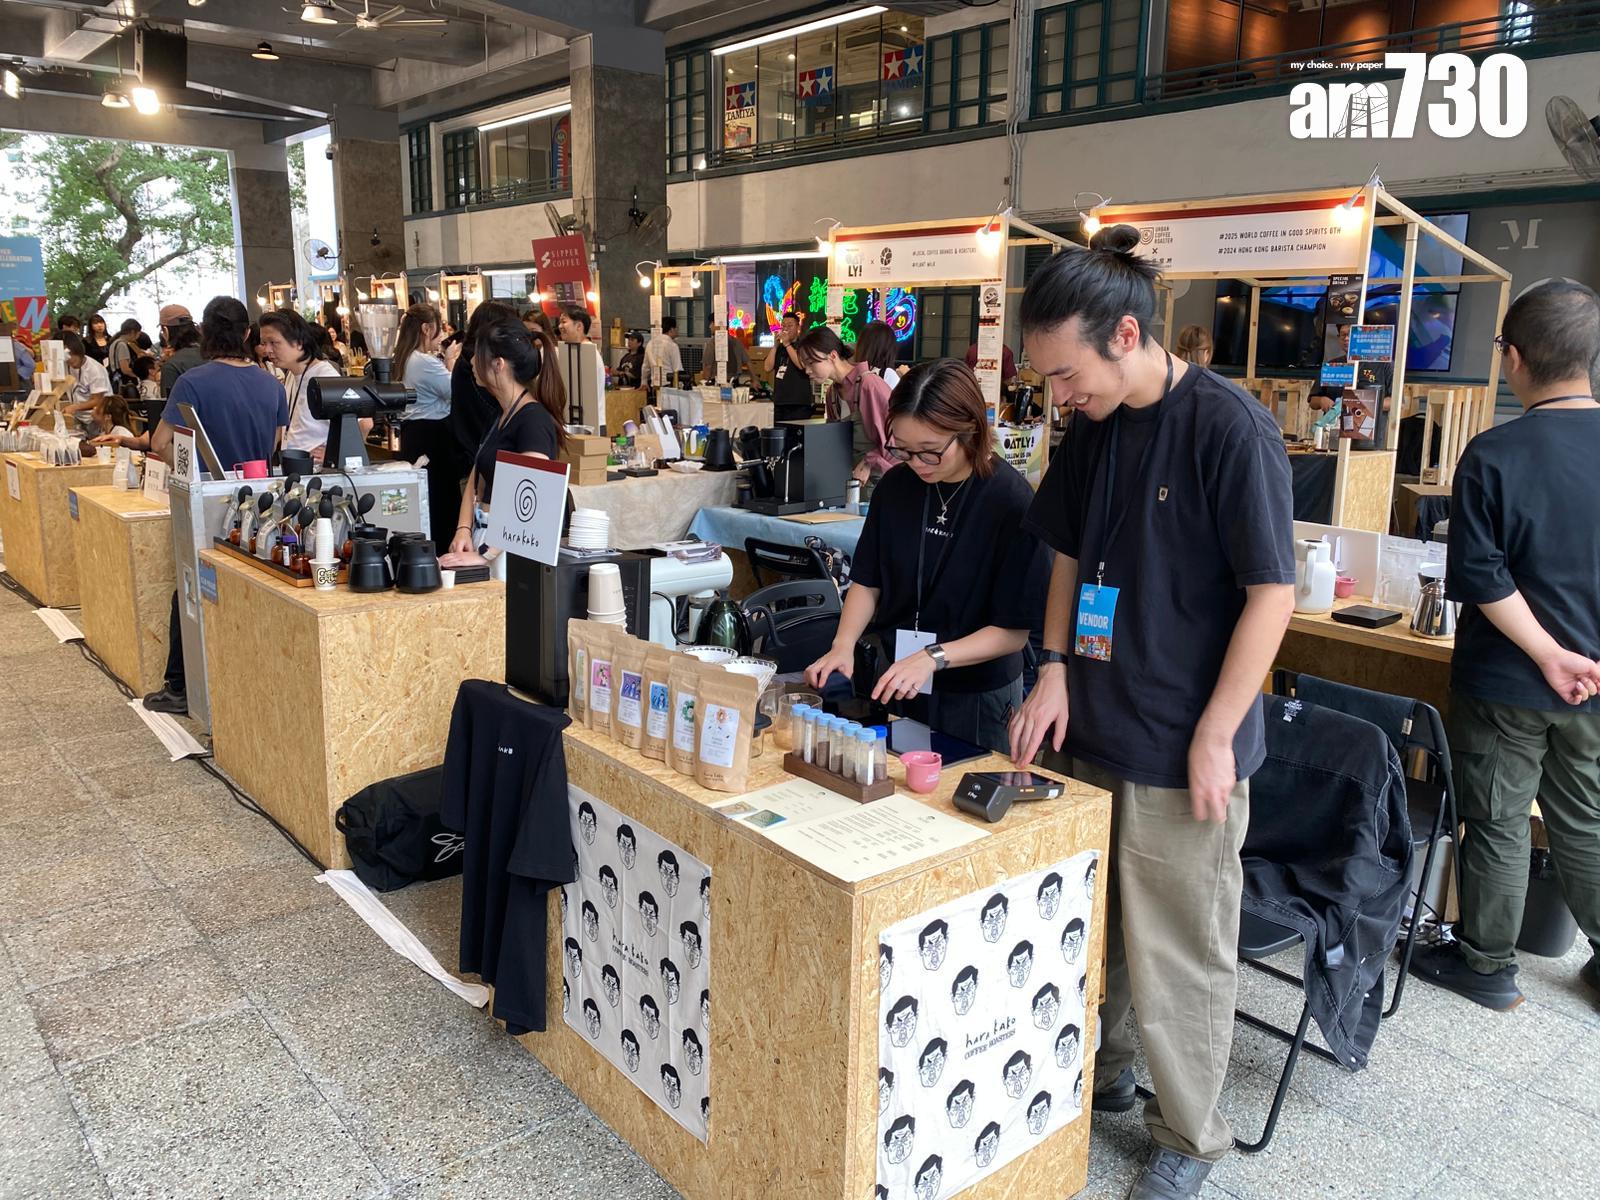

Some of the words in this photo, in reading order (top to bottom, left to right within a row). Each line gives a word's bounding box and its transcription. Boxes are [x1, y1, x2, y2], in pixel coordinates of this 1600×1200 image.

[726, 107, 756, 121] TAMIYA
[1219, 232, 1238, 240] #2025
[1239, 231, 1258, 239] WORLD
[1260, 230, 1279, 238] COFFEE
[1280, 229, 1287, 237] IN
[1288, 229, 1304, 237] GOOD
[1305, 227, 1328, 236] SPIRITS
[1497, 218, 1543, 250] M
[551, 248, 579, 258] SIPPER
[1254, 245, 1269, 253] KONG
[1270, 244, 1294, 252] BARISTA
[1296, 243, 1327, 251] CHAMPION
[552, 258, 580, 267] COFFEE
[848, 264, 863, 277] LY!
[1004, 435, 1035, 450] OATLY!
[1079, 612, 1109, 630] VENDOR
[964, 1044, 988, 1060] COFFEE
[988, 1028, 1016, 1048] ROASTERS
